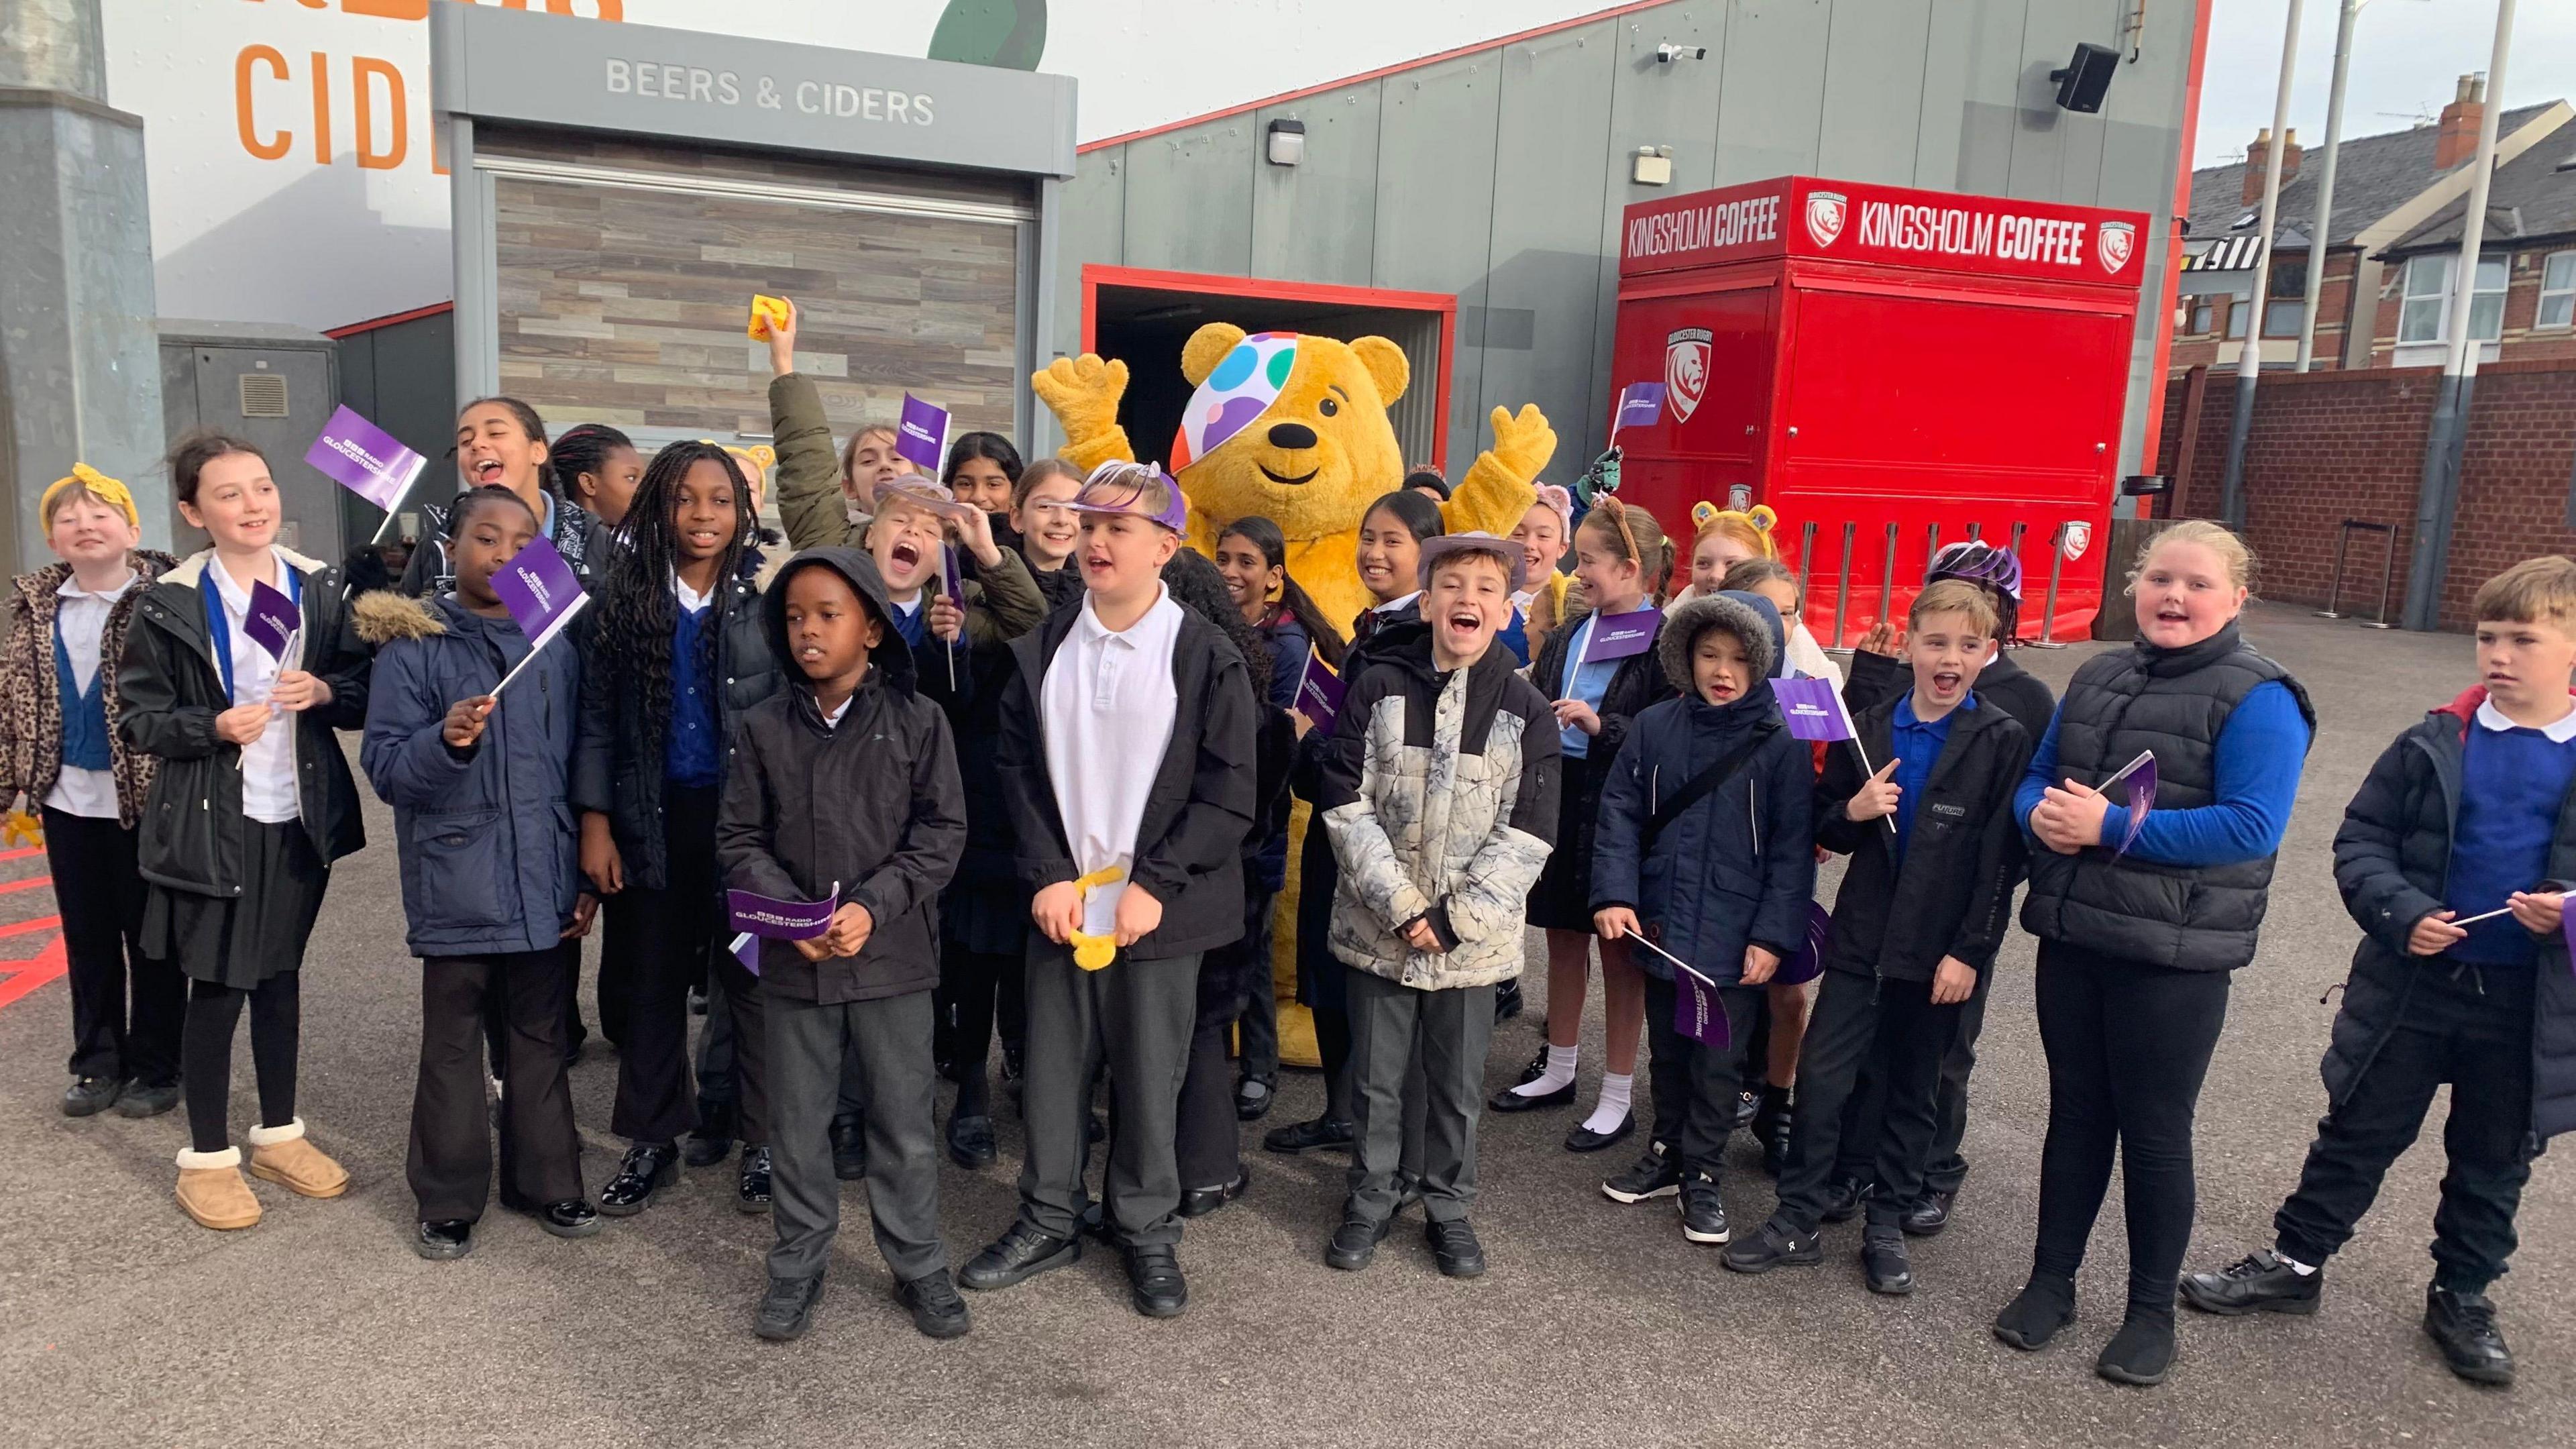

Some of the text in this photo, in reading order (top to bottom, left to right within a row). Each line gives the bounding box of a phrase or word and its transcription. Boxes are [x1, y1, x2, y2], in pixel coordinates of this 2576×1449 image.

[235, 44, 449, 175] CID
[606, 58, 934, 127] BEERS & CIDERS
[1627, 195, 1780, 258] KINGSHOLM COFFEE
[1858, 201, 2086, 265] KINGSHOLM COFFEE
[1668, 328, 1713, 345] GLOUCESTER RUGBY
[323, 436, 396, 484] GLOUCESTERSHIRE
[364, 453, 384, 468] RADIO
[517, 567, 551, 613] GLOUCESTERSHIRE
[1932, 803, 1965, 816] FUTURE
